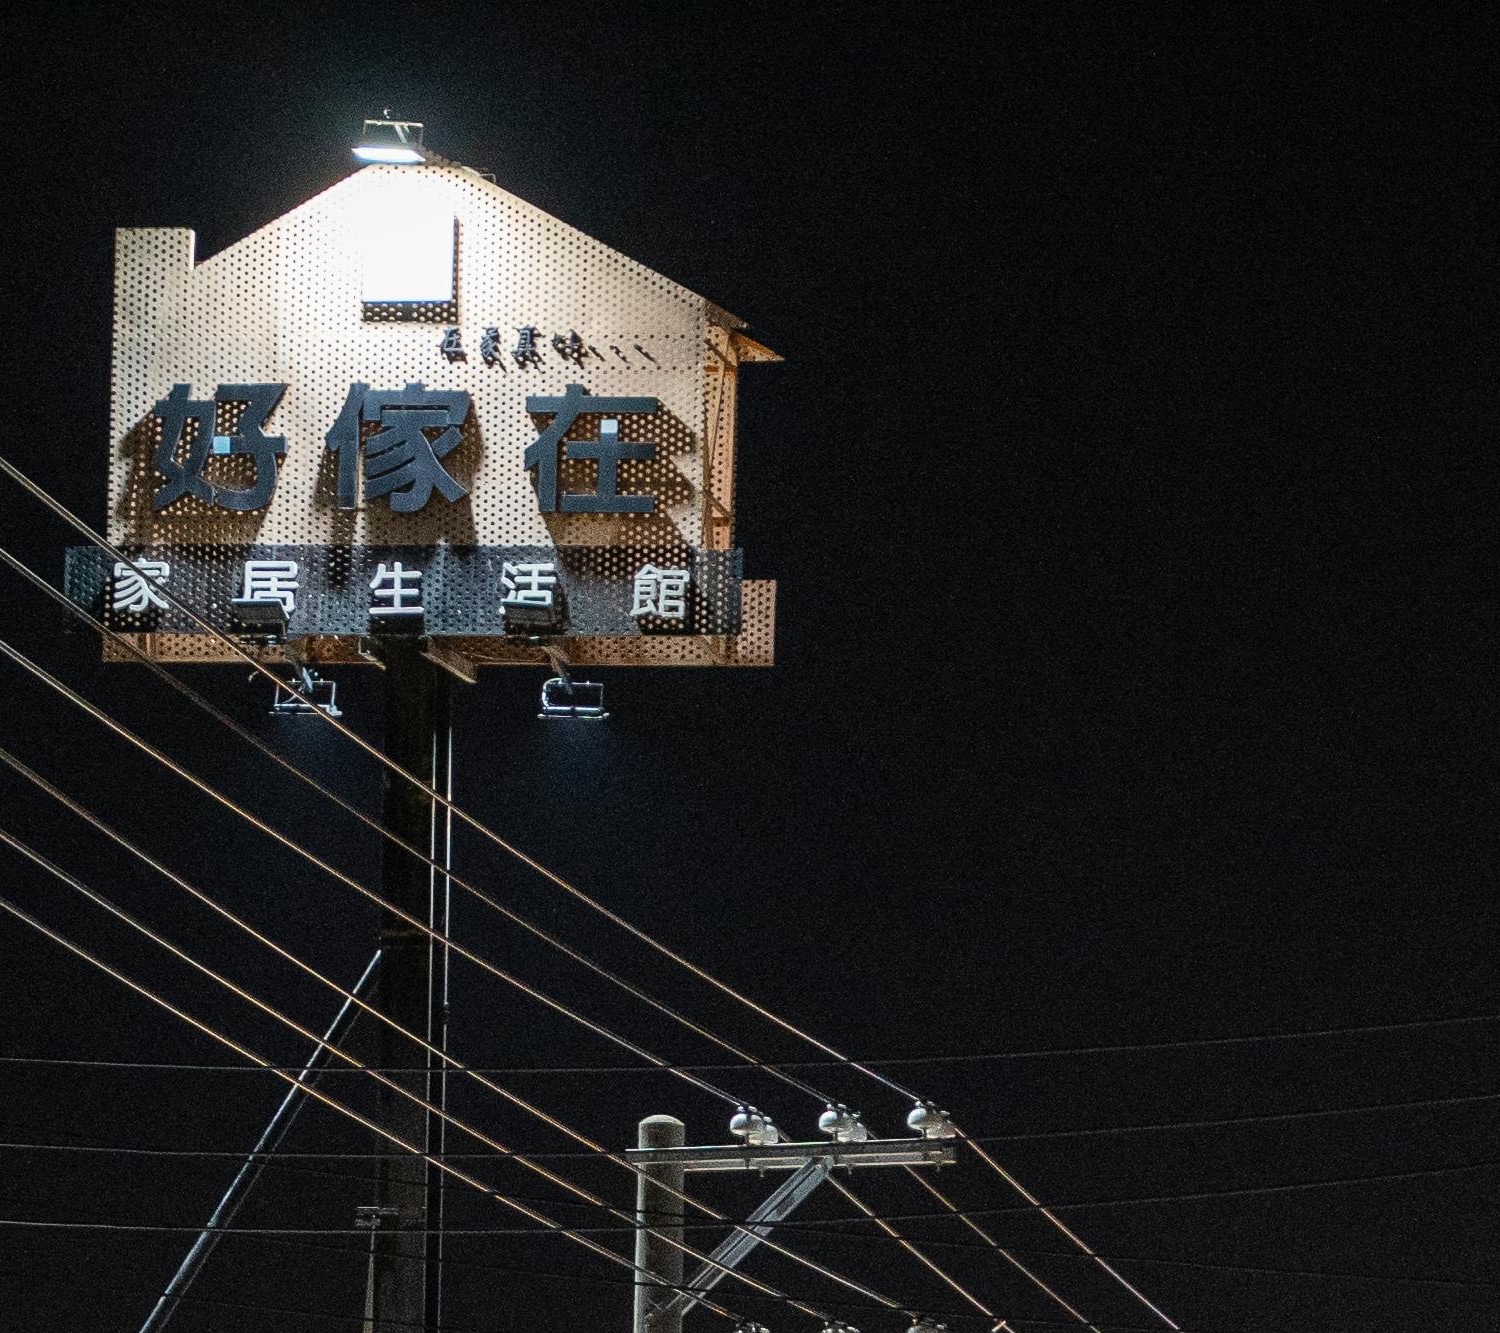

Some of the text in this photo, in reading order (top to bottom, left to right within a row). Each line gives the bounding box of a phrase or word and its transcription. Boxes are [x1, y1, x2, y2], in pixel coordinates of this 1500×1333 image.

[151, 380, 661, 515] 好傢在
[111, 558, 691, 622] 家居生活館
